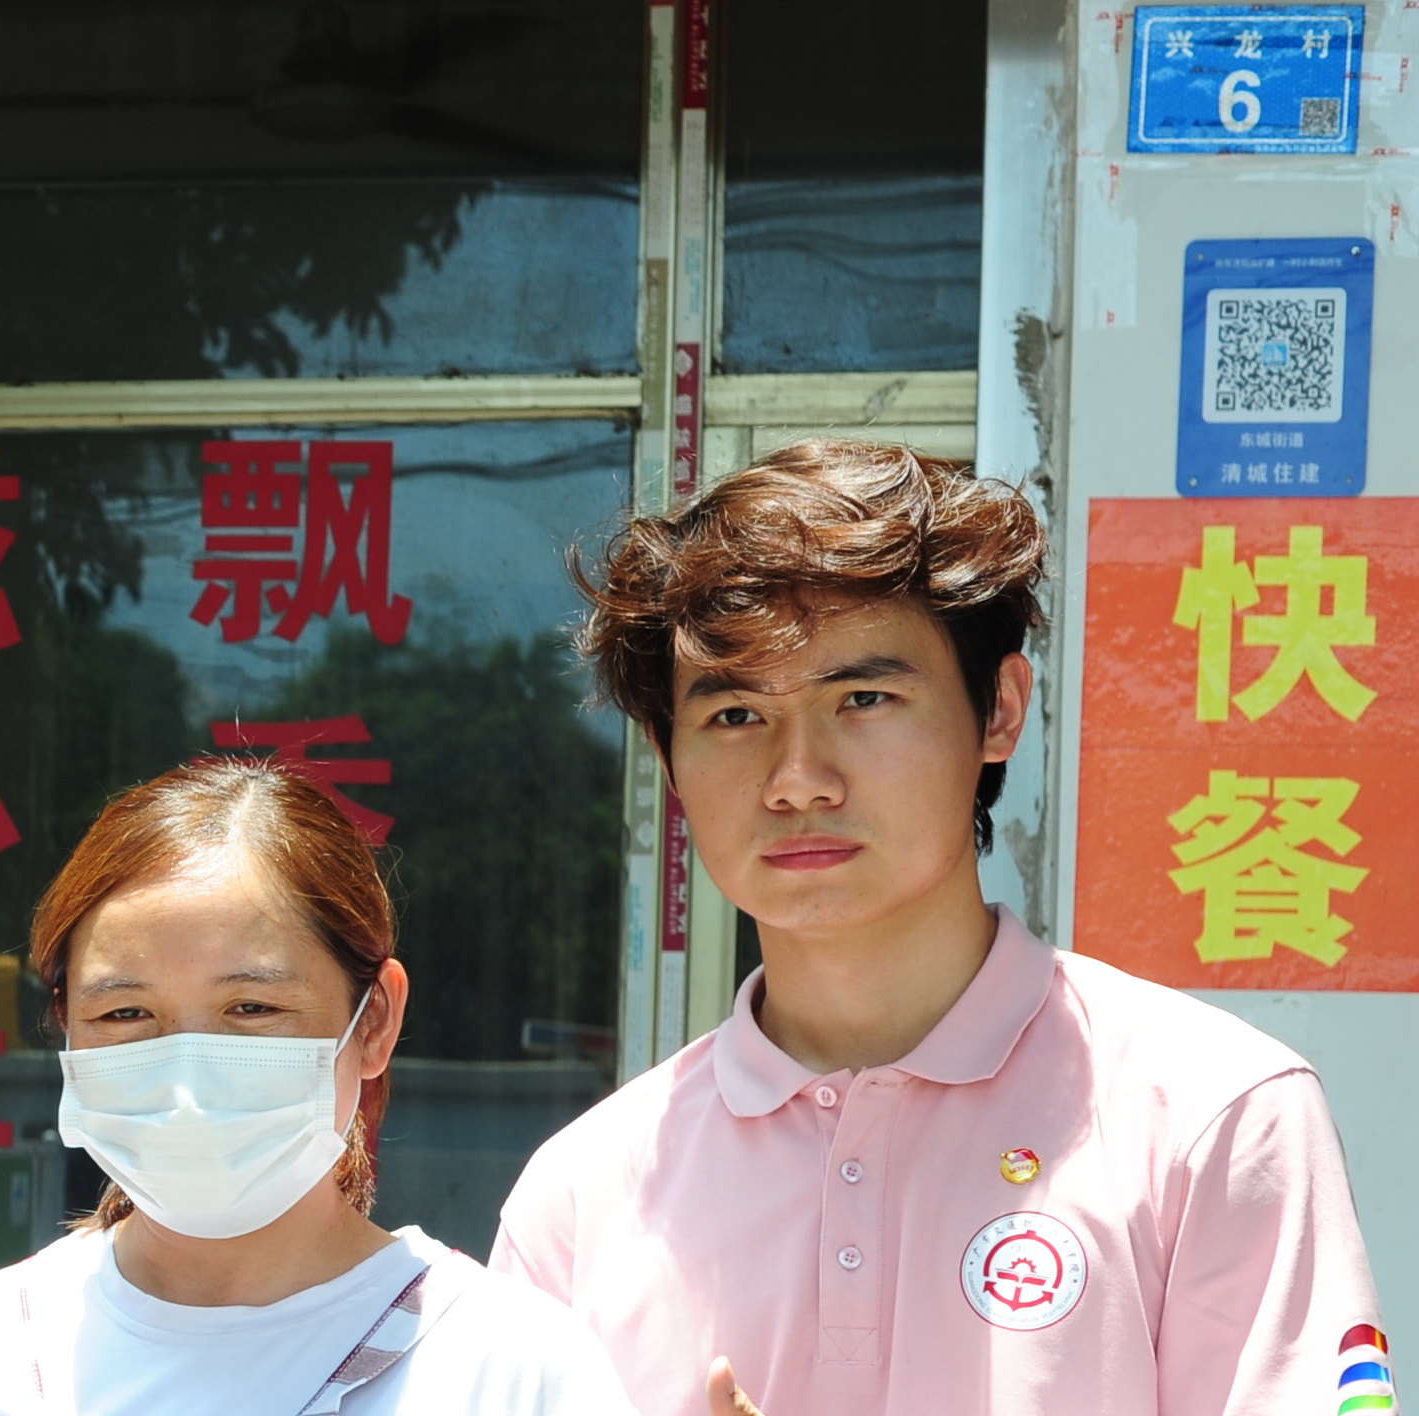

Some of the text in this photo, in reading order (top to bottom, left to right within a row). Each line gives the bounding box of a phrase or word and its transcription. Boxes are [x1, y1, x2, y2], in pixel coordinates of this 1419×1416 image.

[1165, 29, 1332, 59] 兴龙村
[1218, 69, 1261, 133] 6
[1240, 431, 1305, 449] 东城街道
[1221, 461, 1321, 484] 清城住建
[1166, 525, 1378, 968] 快餐
